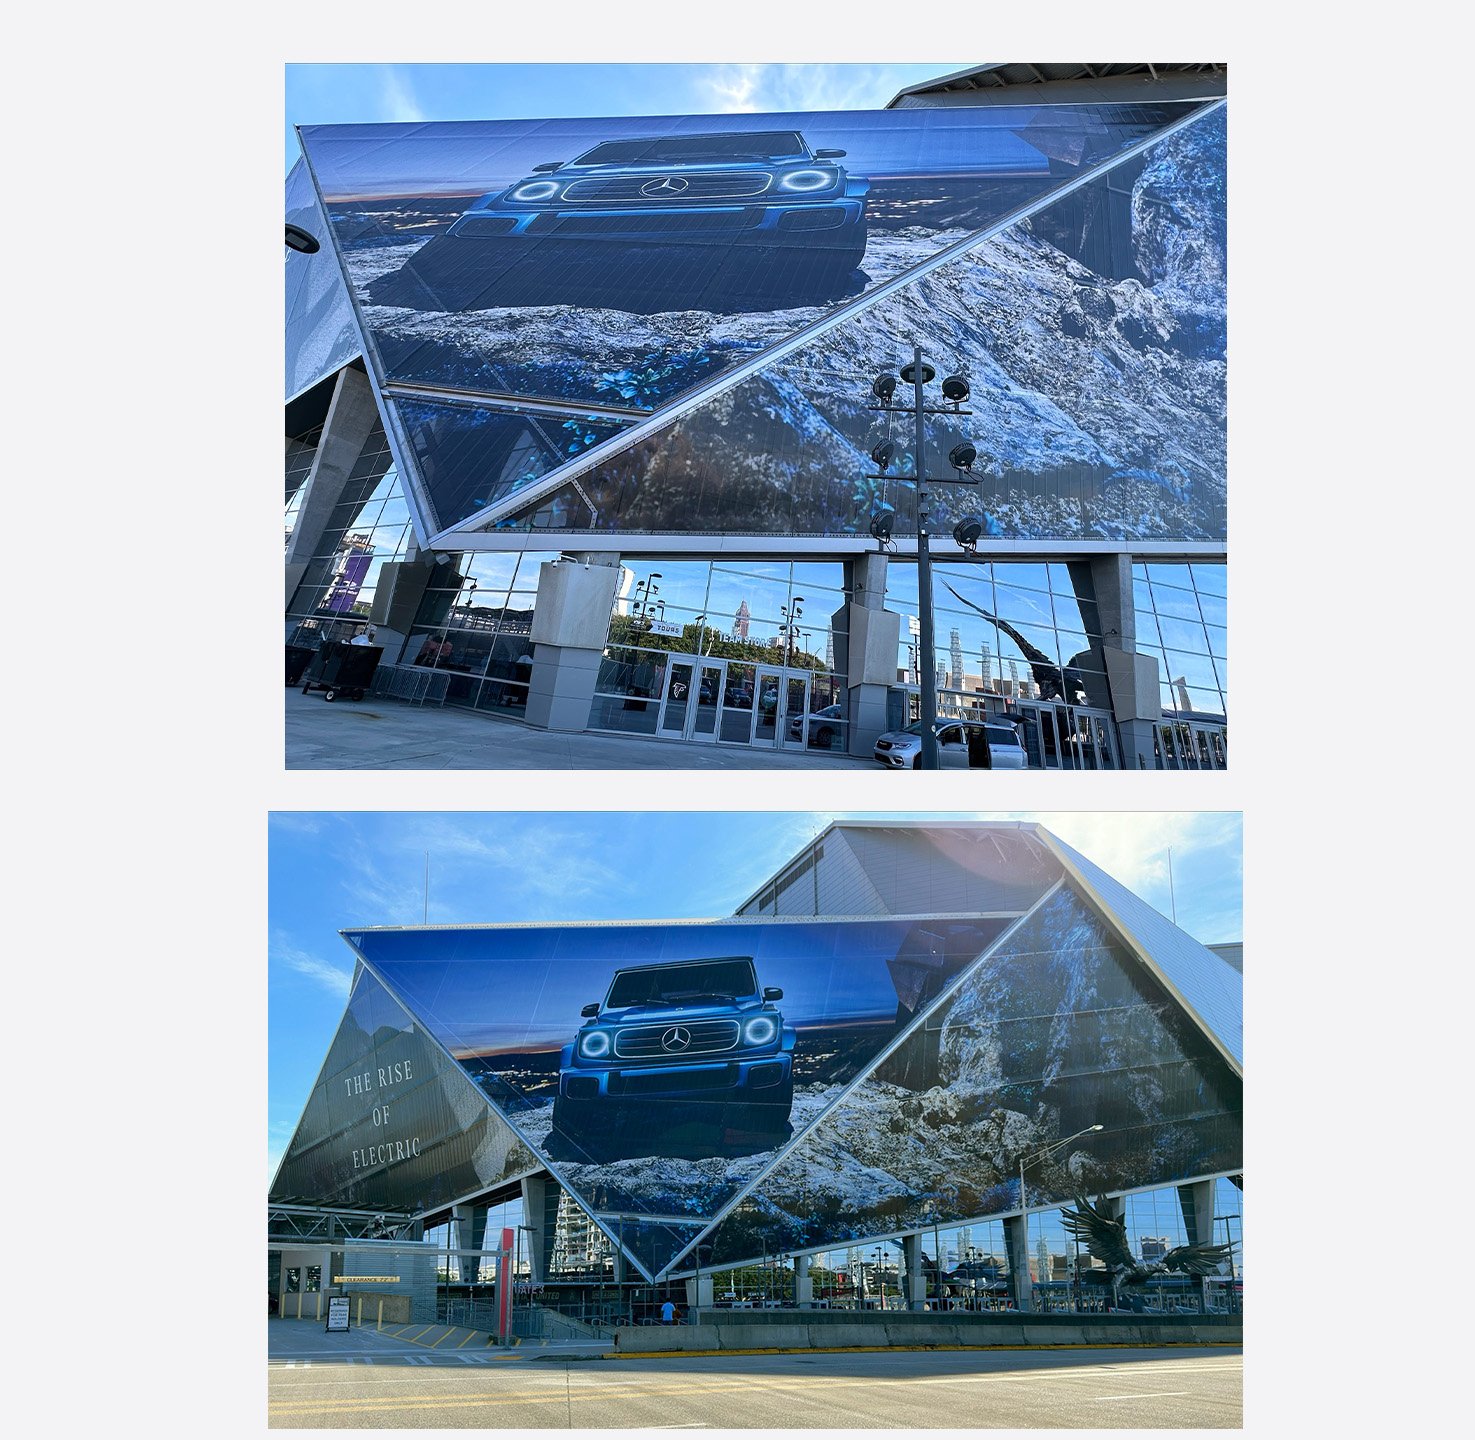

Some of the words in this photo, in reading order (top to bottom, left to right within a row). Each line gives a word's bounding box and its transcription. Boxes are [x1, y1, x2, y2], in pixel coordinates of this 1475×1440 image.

[657, 624, 680, 634] TOURS
[719, 631, 742, 644] TEAM
[744, 636, 772, 649] STORE
[345, 1072, 372, 1097] THE
[377, 1060, 413, 1088] RISE
[372, 1105, 390, 1127] OF
[352, 1137, 421, 1169] ELECTRIC
